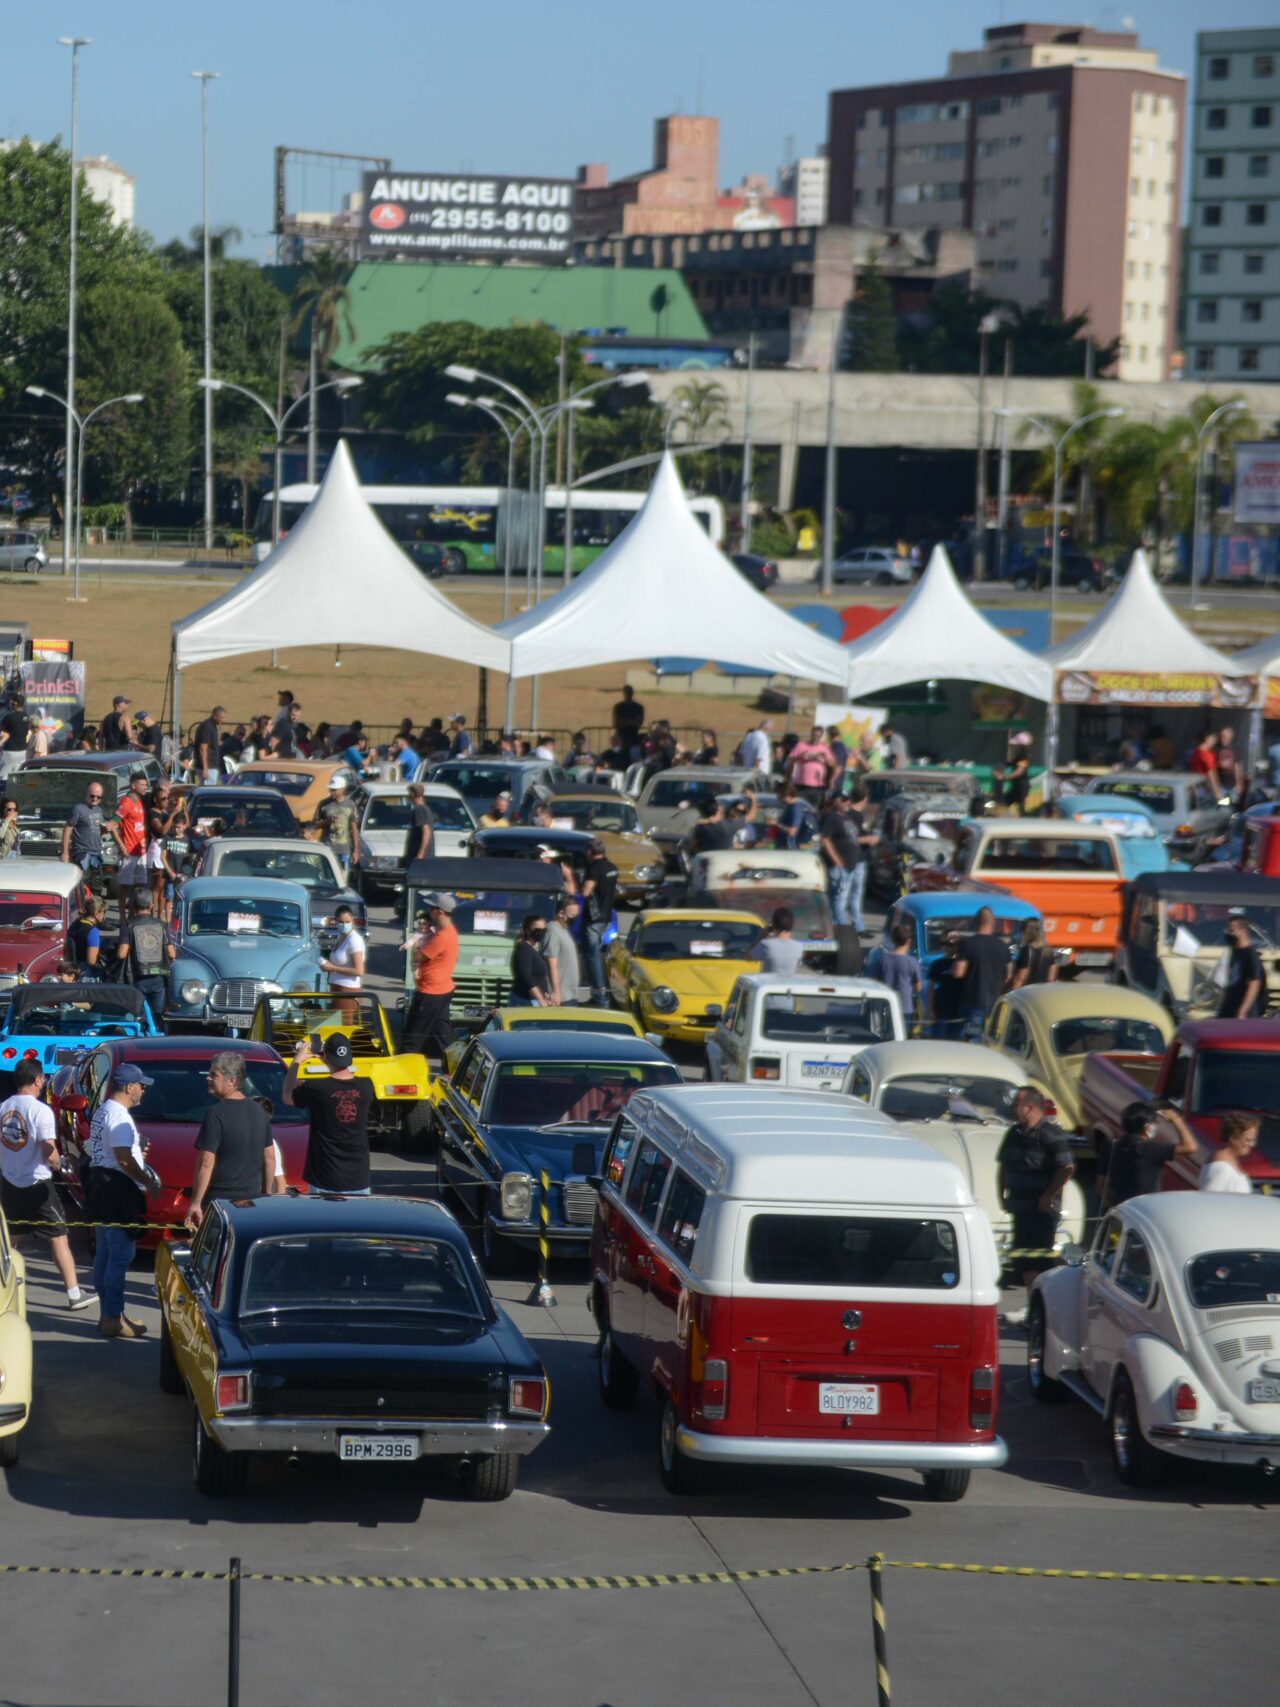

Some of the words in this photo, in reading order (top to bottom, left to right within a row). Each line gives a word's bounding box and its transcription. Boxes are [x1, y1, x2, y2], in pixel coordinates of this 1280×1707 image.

[370, 178, 496, 203] ANUNCIE
[502, 183, 569, 207] AQUI
[430, 208, 568, 234] 2955-8100
[24, 679, 80, 695] DrinkS!
